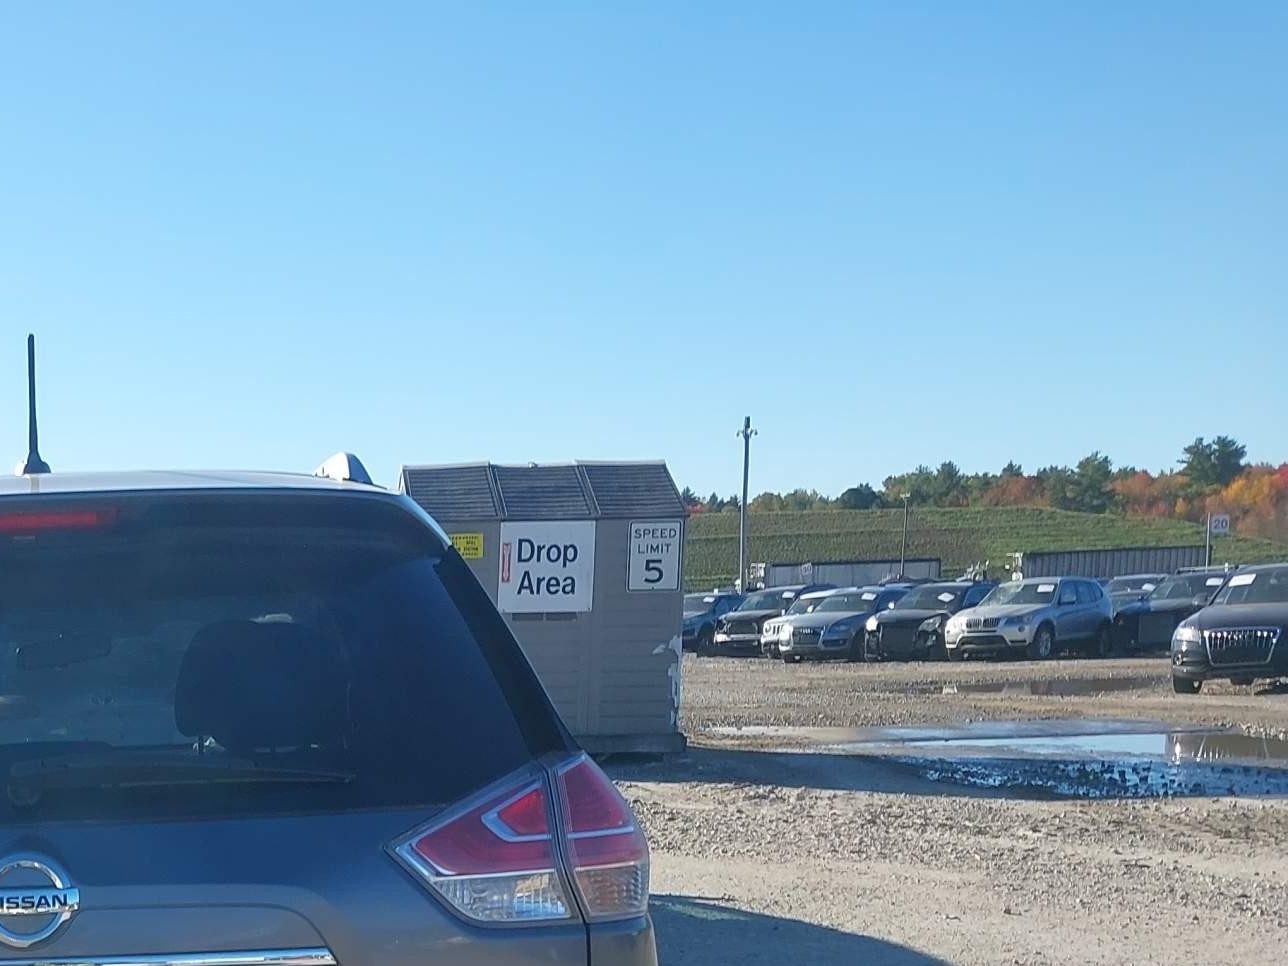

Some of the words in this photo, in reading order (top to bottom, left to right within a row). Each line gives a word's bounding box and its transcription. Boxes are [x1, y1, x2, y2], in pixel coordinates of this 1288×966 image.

[634, 527, 677, 539] SPEED
[517, 538, 578, 568] Drop
[637, 543, 672, 554] LIMIT
[516, 570, 576, 595] Area
[643, 559, 664, 583] 5
